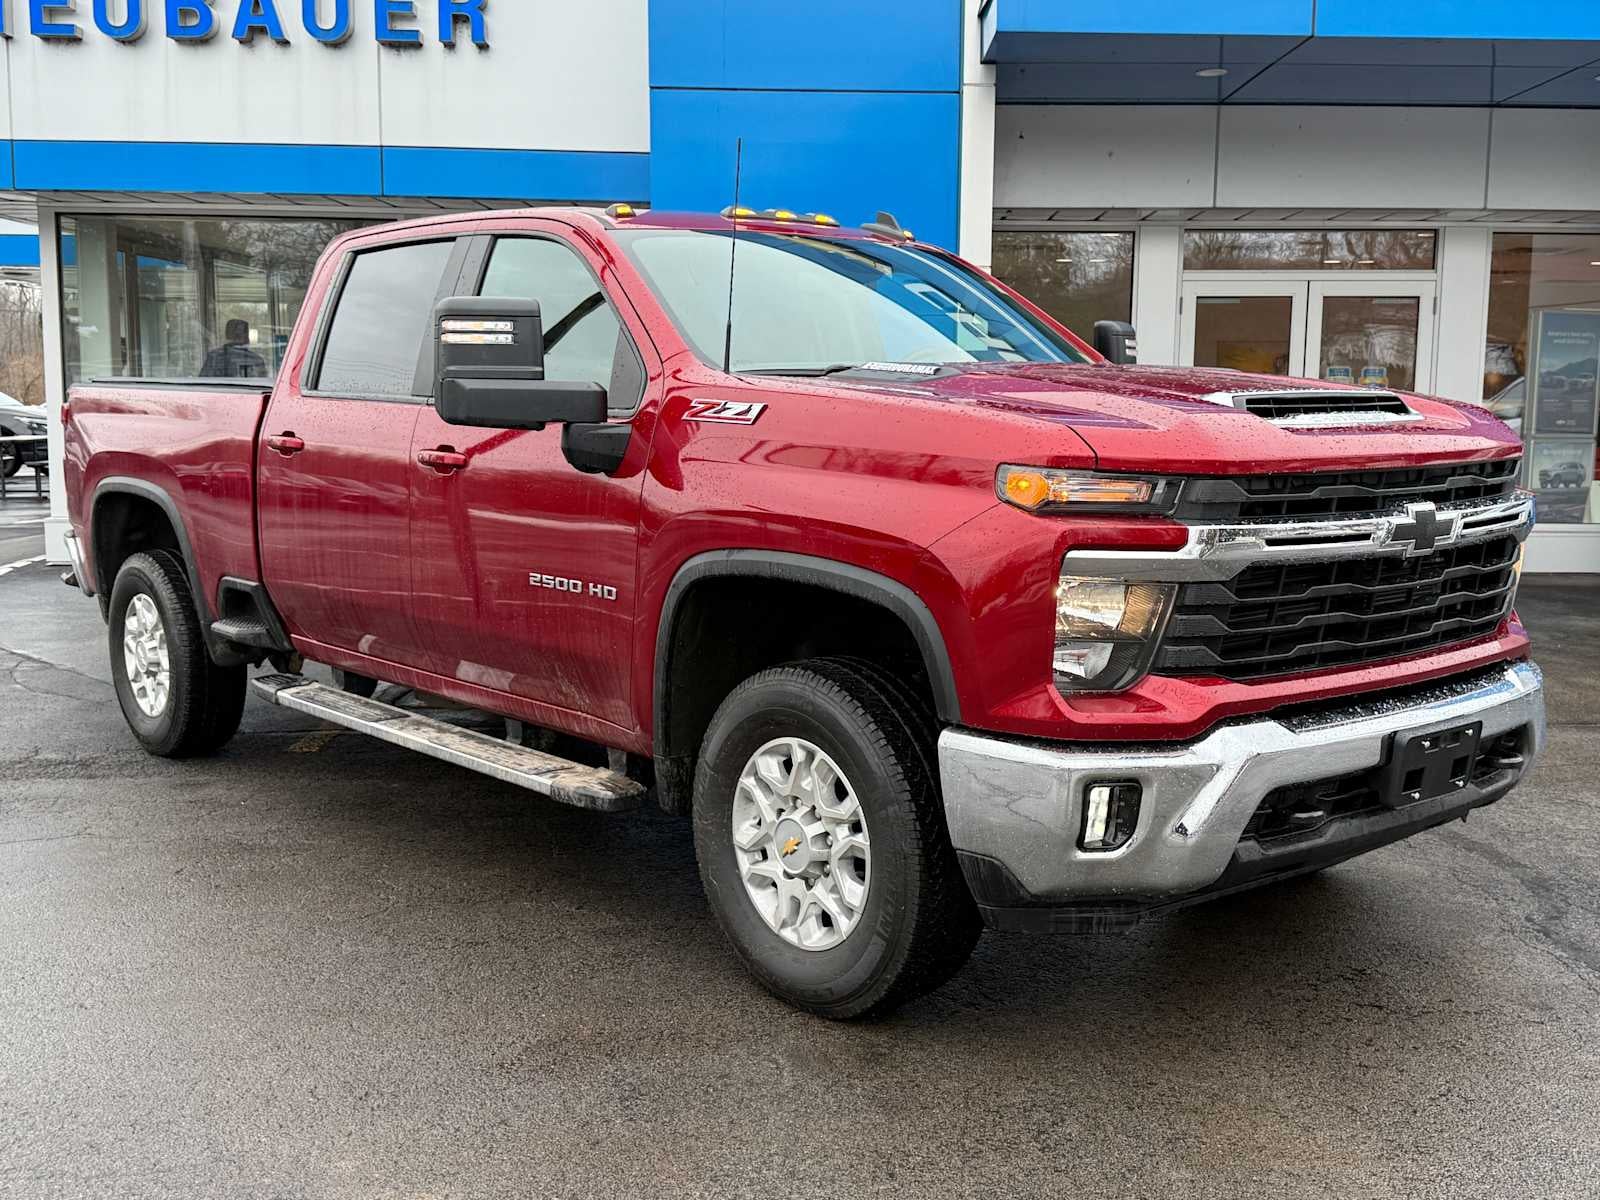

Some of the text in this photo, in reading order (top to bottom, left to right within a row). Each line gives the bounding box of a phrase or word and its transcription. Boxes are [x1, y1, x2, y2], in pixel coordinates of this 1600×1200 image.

[0, 0, 488, 47] EUBAUER
[681, 398, 768, 425] Z71
[529, 572, 617, 600] 2500 HD
